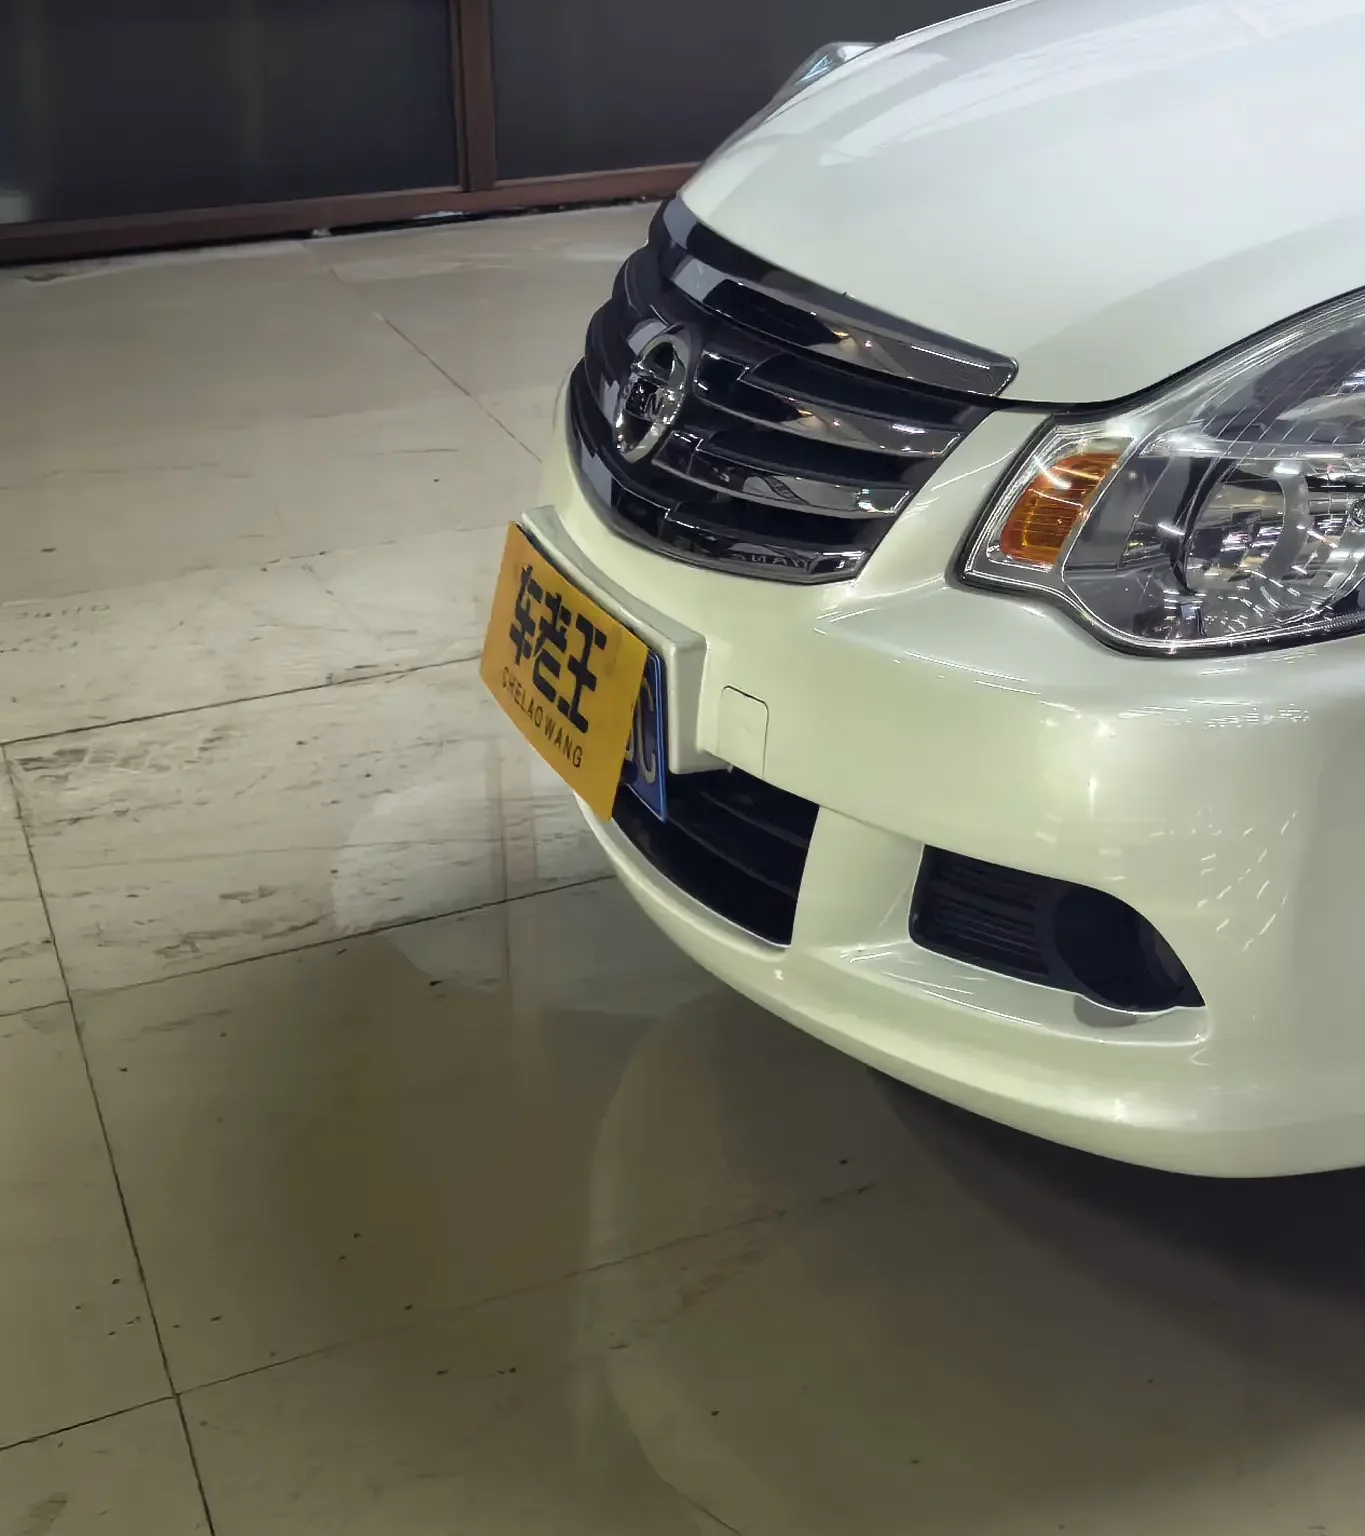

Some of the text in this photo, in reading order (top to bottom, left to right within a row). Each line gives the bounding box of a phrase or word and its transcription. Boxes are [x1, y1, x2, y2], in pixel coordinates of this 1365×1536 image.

[501, 665, 584, 769] CHELAOWANG
[508, 564, 608, 734] 车老王
